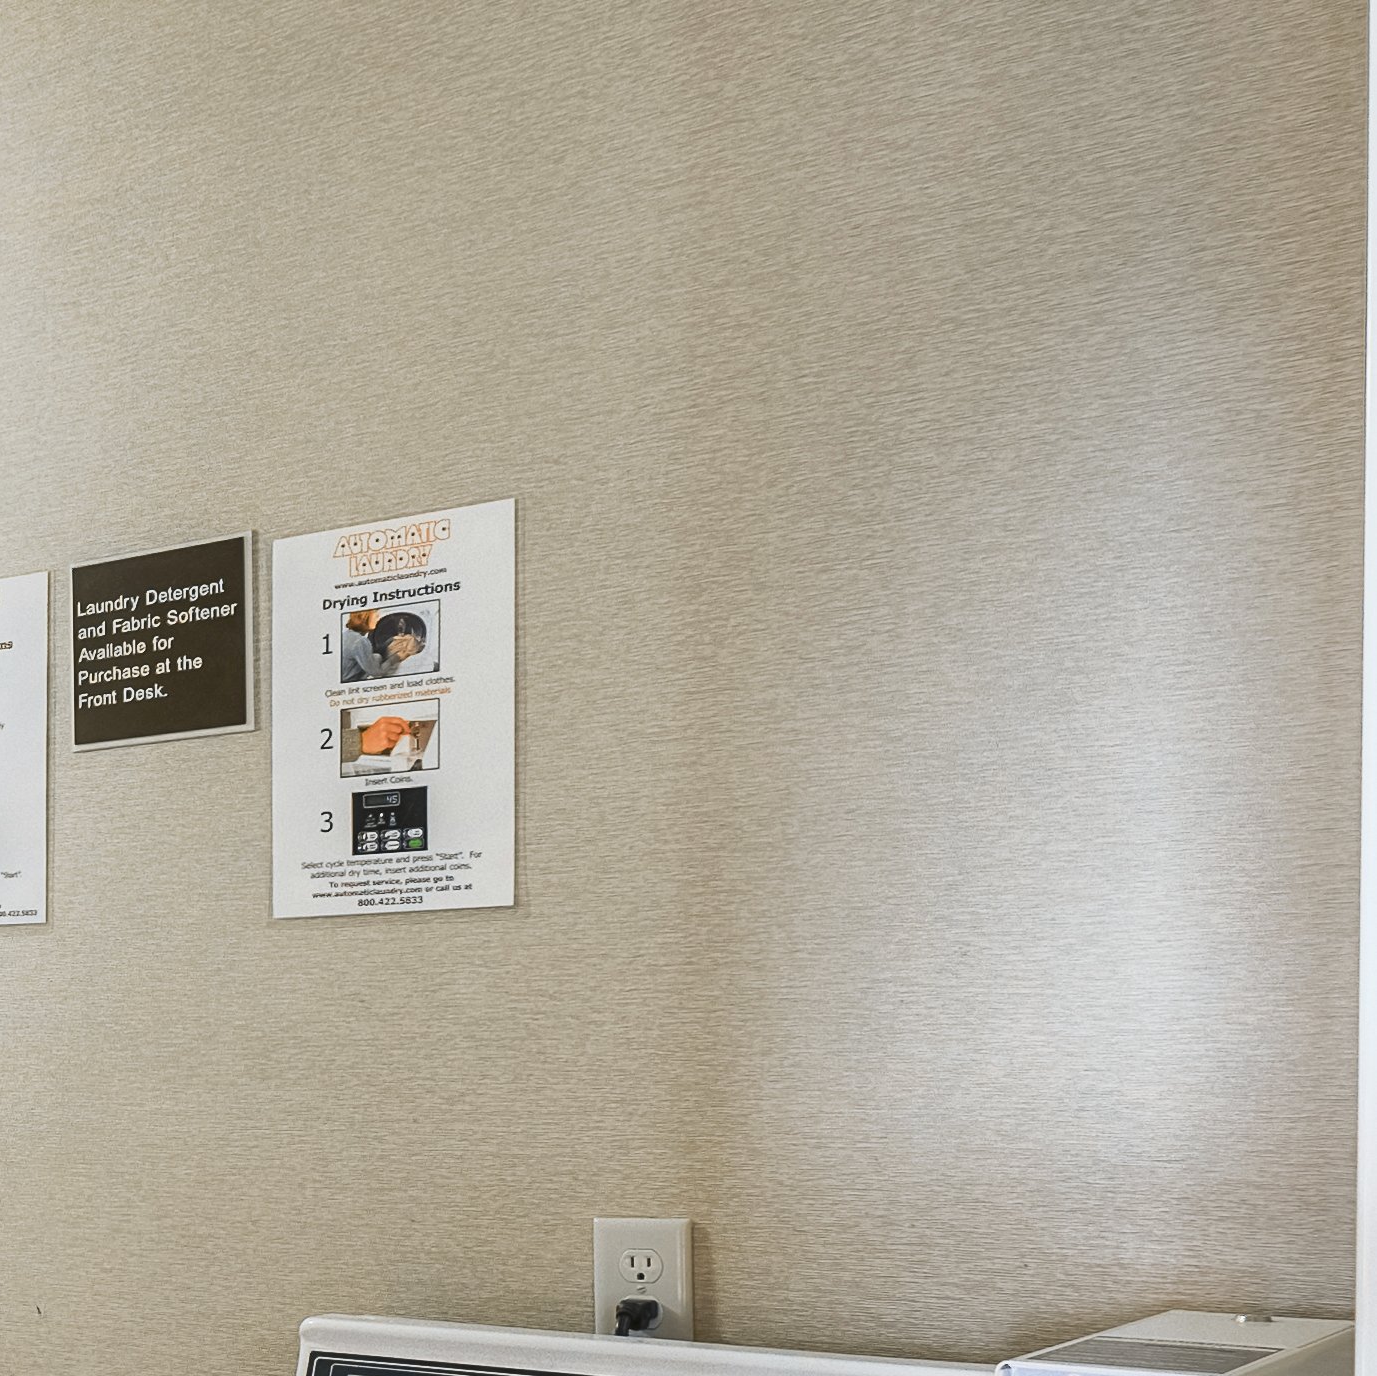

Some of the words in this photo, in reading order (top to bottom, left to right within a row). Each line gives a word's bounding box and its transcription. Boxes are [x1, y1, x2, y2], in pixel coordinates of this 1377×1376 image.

[333, 518, 451, 558] AUTOMATIC
[349, 544, 433, 578] LAUNDRY
[77, 595, 139, 617] Laundry
[146, 578, 225, 605] Detergent
[323, 595, 367, 610] Drying
[373, 581, 461, 603] Instructions
[78, 623, 106, 640] and
[112, 618, 161, 634] Fabric
[167, 602, 238, 625] Softener
[78, 639, 146, 663] Available
[152, 635, 175, 651] for
[321, 633, 333, 655] 1
[79, 664, 150, 686] Purchase
[155, 658, 171, 673] at
[177, 655, 203, 671] the
[78, 692, 117, 709] Front
[123, 683, 168, 702] Desk.
[325, 689, 346, 698] Clean
[348, 687, 359, 695] lint
[362, 684, 387, 692] screen
[390, 681, 404, 689] and
[407, 679, 423, 687] load
[342, 698, 355, 706] not
[357, 696, 369, 706] dry
[320, 728, 334, 750] 2
[365, 778, 387, 786] Insert
[320, 811, 334, 833] 3
[301, 862, 323, 870] Select
[325, 861, 344, 869] cycle
[347, 856, 393, 867] temperature
[396, 856, 410, 864] and
[412, 855, 433, 864] press
[469, 851, 483, 859] For
[310, 869, 346, 879] additional
[348, 869, 360, 877] dry
[408, 863, 446, 872] additional
[340, 880, 370, 889] request
[404, 877, 431, 886] please
